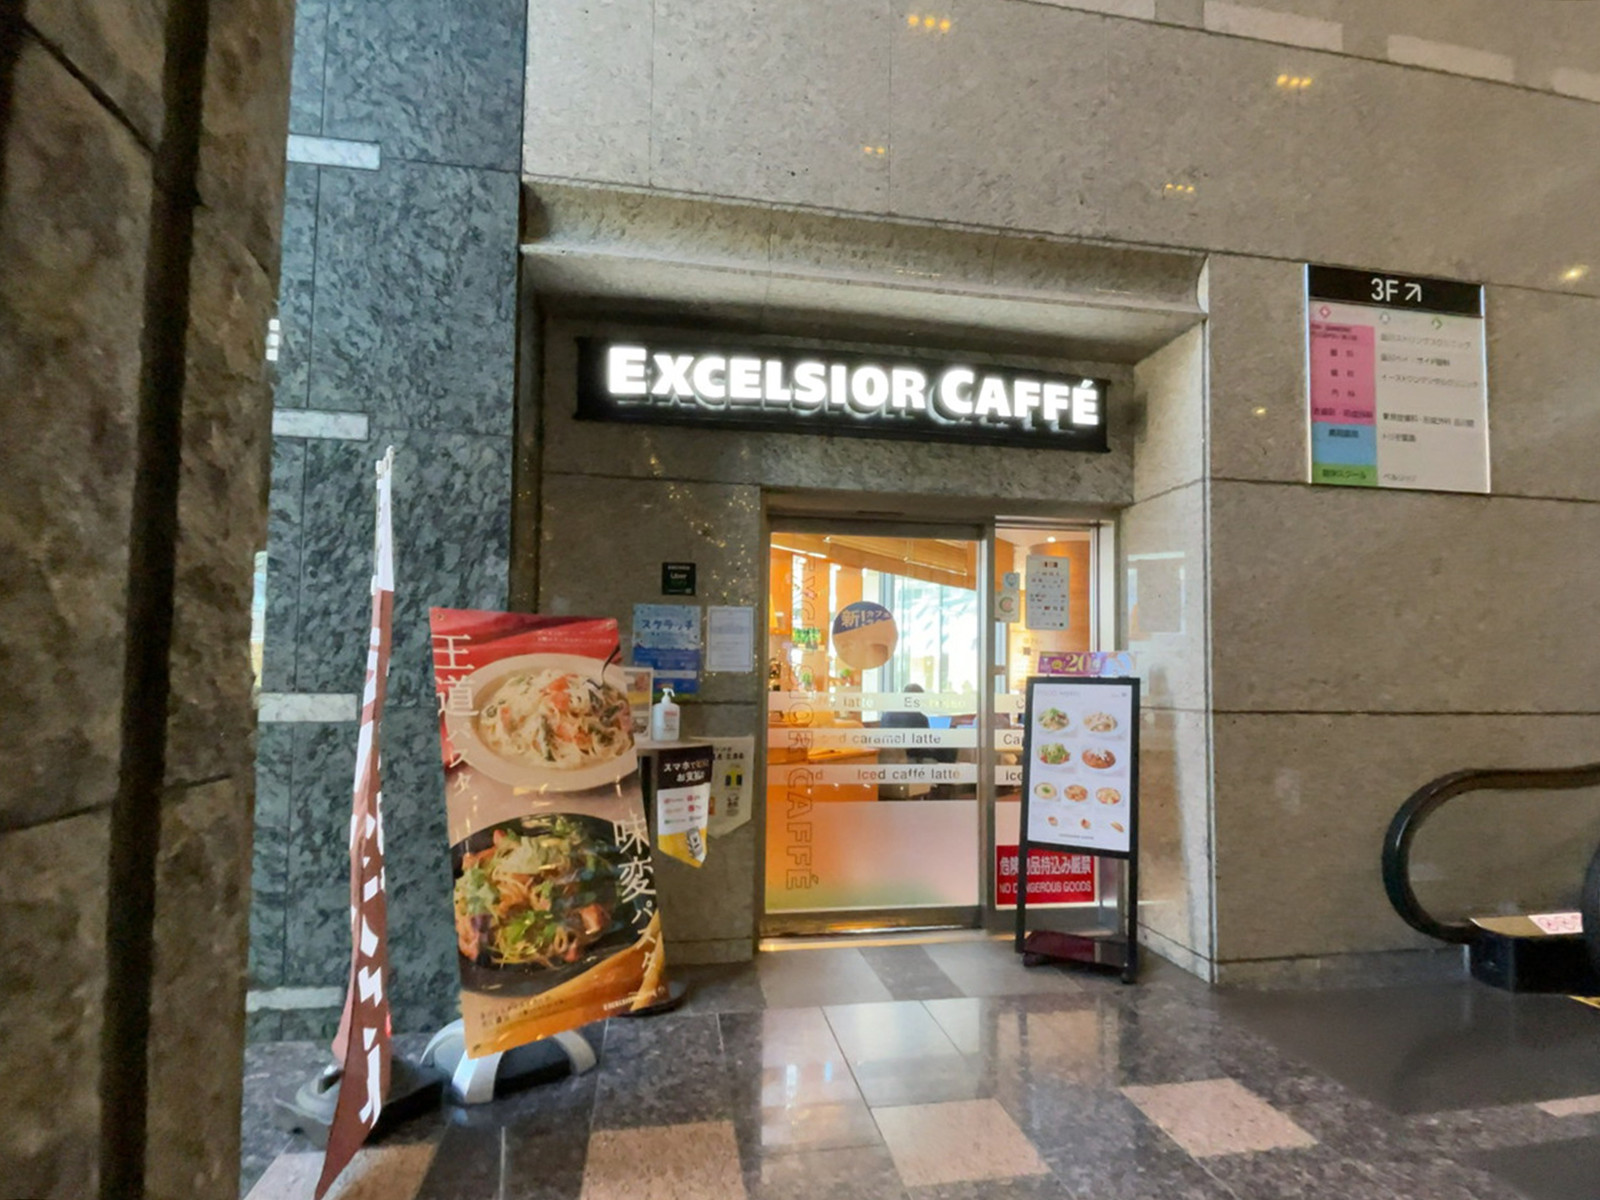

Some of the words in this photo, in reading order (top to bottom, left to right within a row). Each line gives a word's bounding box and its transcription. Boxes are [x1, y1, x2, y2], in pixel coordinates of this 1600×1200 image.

[1371, 277, 1399, 302] 3F
[608, 345, 926, 410] EXCELSIOR
[941, 368, 1099, 425] CAFFÉ
[641, 619, 693, 631] スクラッチ
[787, 556, 816, 753] EXCLSIOR
[852, 732, 906, 744] caramel
[911, 732, 942, 744] latte
[1003, 733, 1023, 746] Ca
[857, 769, 887, 780] Iced
[892, 767, 926, 780] caffé
[931, 768, 961, 780] latte
[786, 767, 819, 890] CAFFÉ
[999, 855, 1092, 876] 危険品持込み厳禁
[1012, 881, 1062, 895] DNGEROUS
[1063, 880, 1092, 893] GOODS
